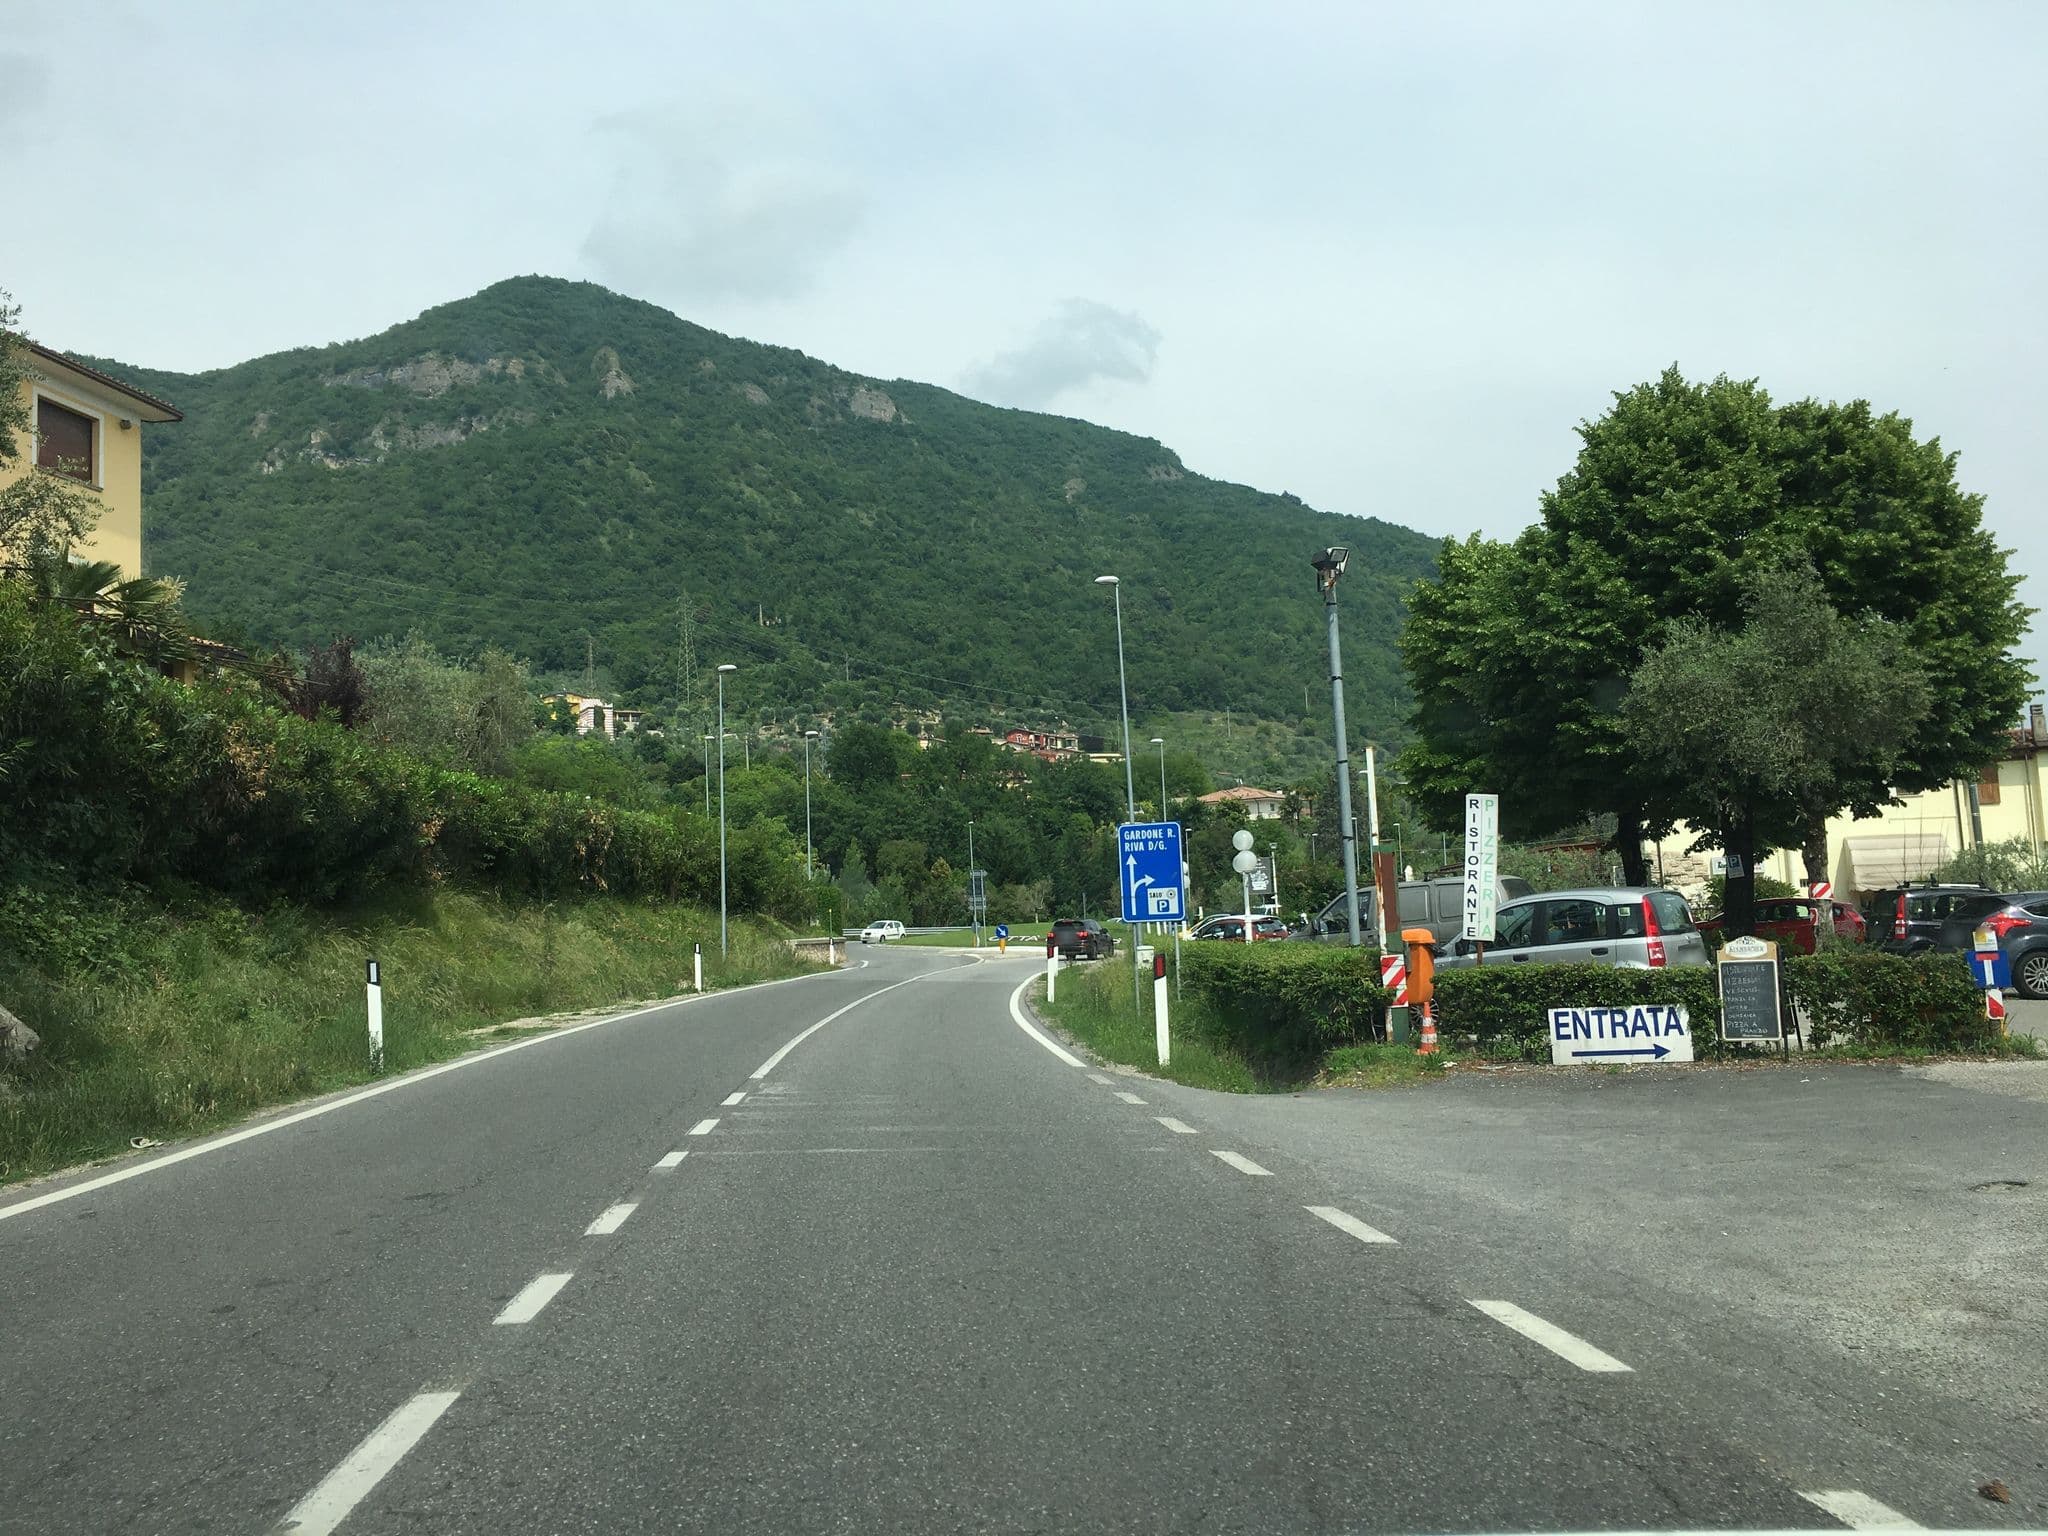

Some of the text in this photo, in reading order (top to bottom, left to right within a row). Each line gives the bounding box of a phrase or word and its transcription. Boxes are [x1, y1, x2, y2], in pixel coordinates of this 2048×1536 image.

[1124, 828, 1177, 841] GARDONE R.
[1124, 841, 1168, 852] RIVA D/G.
[1467, 799, 1480, 937] RISTORANTE
[1482, 799, 1494, 937] PIZZERIA
[1554, 1006, 1685, 1040] ENTRATA
